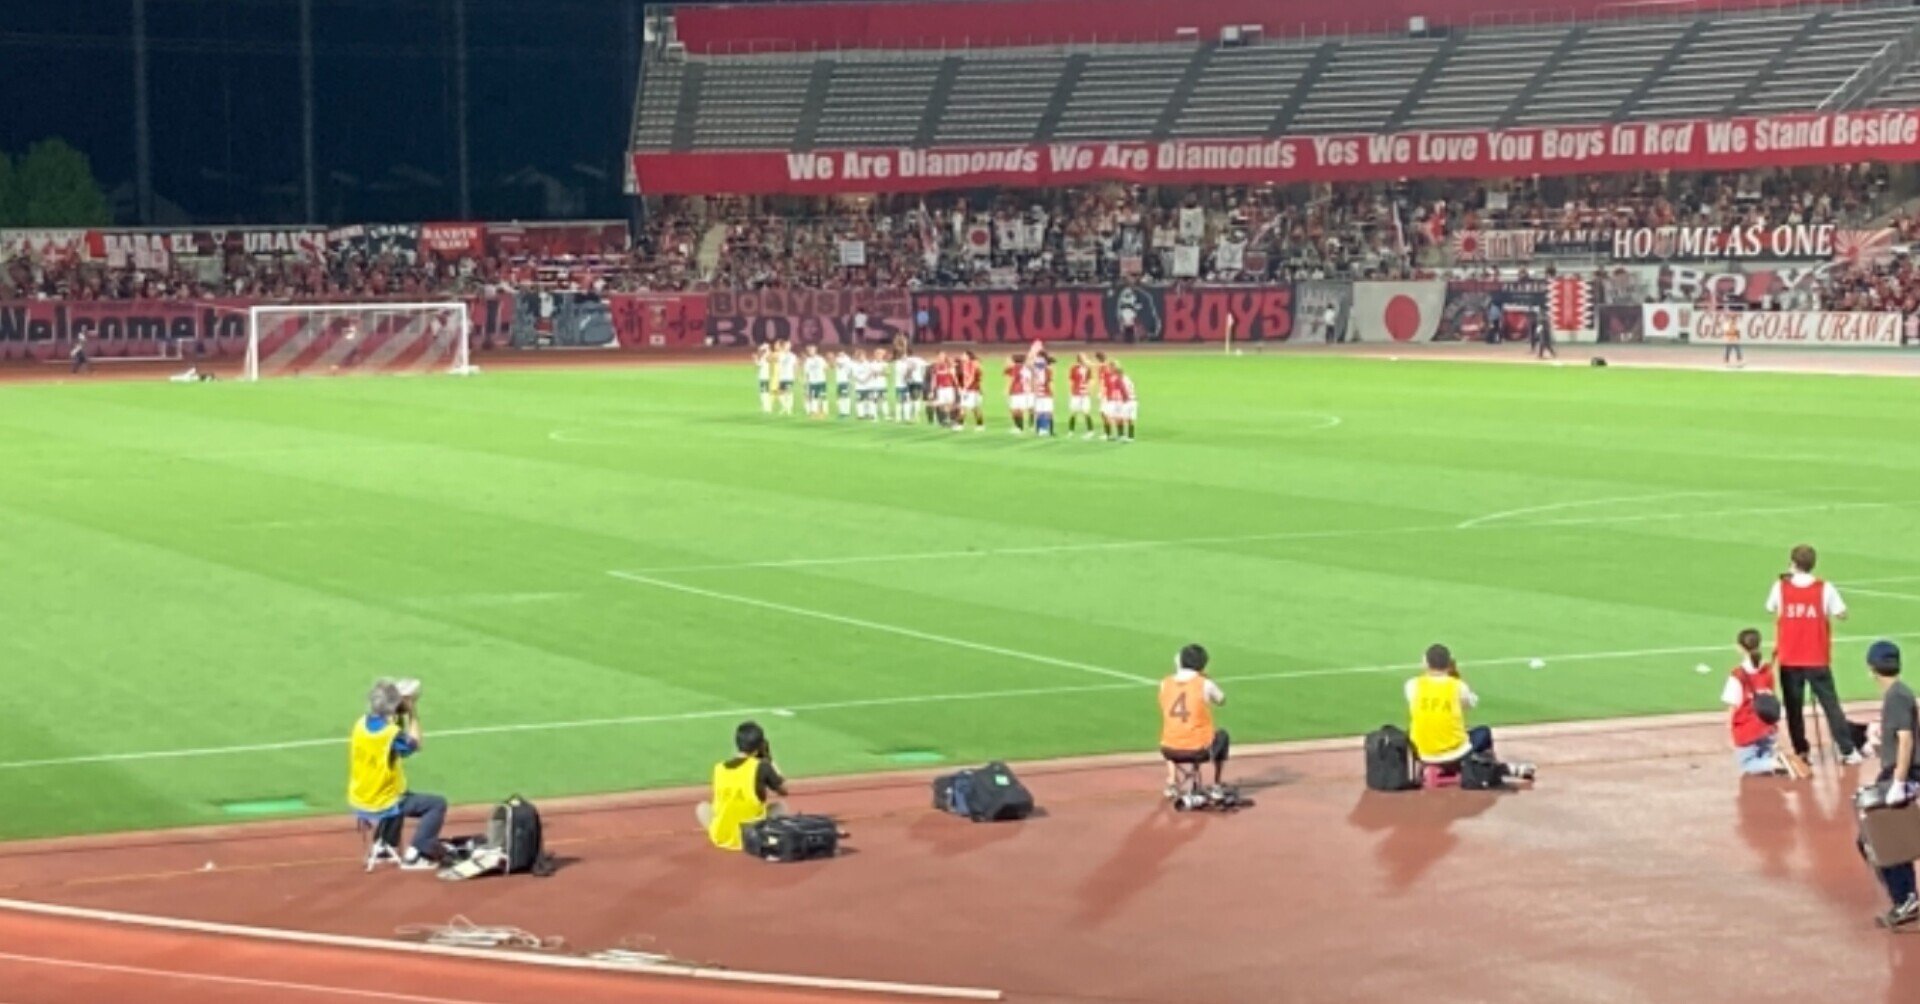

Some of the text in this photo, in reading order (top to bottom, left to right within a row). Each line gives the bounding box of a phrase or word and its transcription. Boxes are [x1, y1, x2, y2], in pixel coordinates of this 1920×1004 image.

[787, 112, 1918, 180] We Are Diamonds We Are Diamonds Yes We Love You Boys In Red We Stand Beside
[1724, 224, 1765, 256] AS
[1771, 224, 1834, 255] ONE
[1163, 290, 1293, 341] BOYS
[1747, 312, 1808, 339] GOAL
[1817, 313, 1898, 341] URAWA
[1786, 603, 1818, 619] SPA
[1169, 691, 1192, 724] 4
[1420, 697, 1452, 713] SPA
